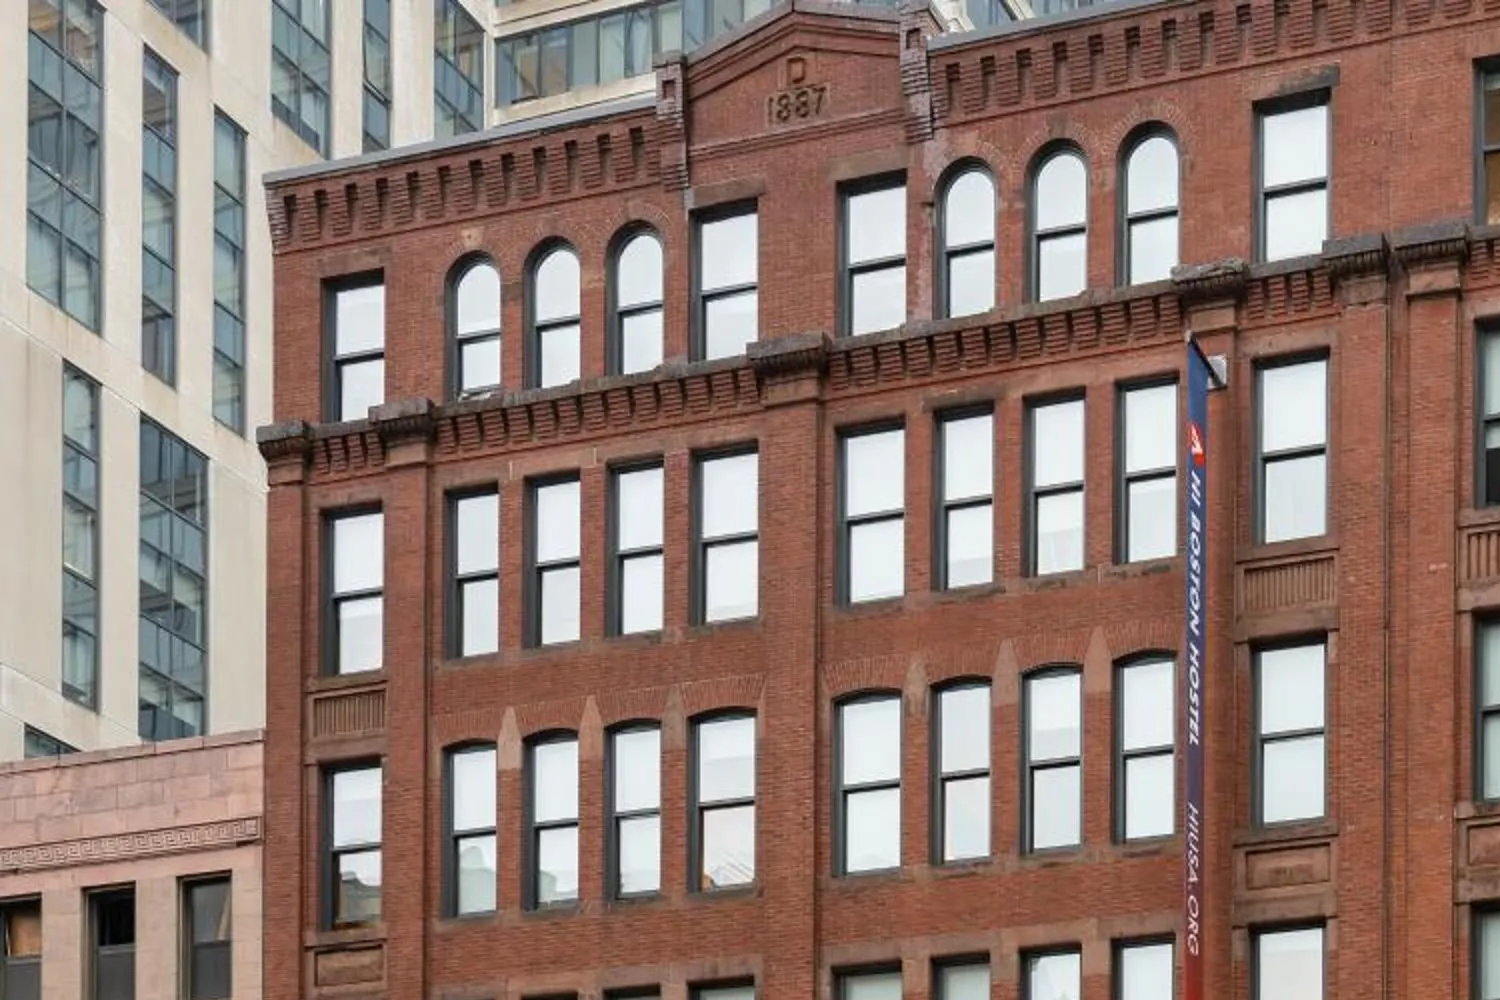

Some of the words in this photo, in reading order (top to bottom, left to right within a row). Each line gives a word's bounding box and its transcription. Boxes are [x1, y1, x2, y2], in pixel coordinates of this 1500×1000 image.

[768, 86, 827, 124] 1887
[1191, 469, 1201, 508] HI
[1188, 510, 1201, 636] BOSTON
[1188, 642, 1200, 746] HOSTEL
